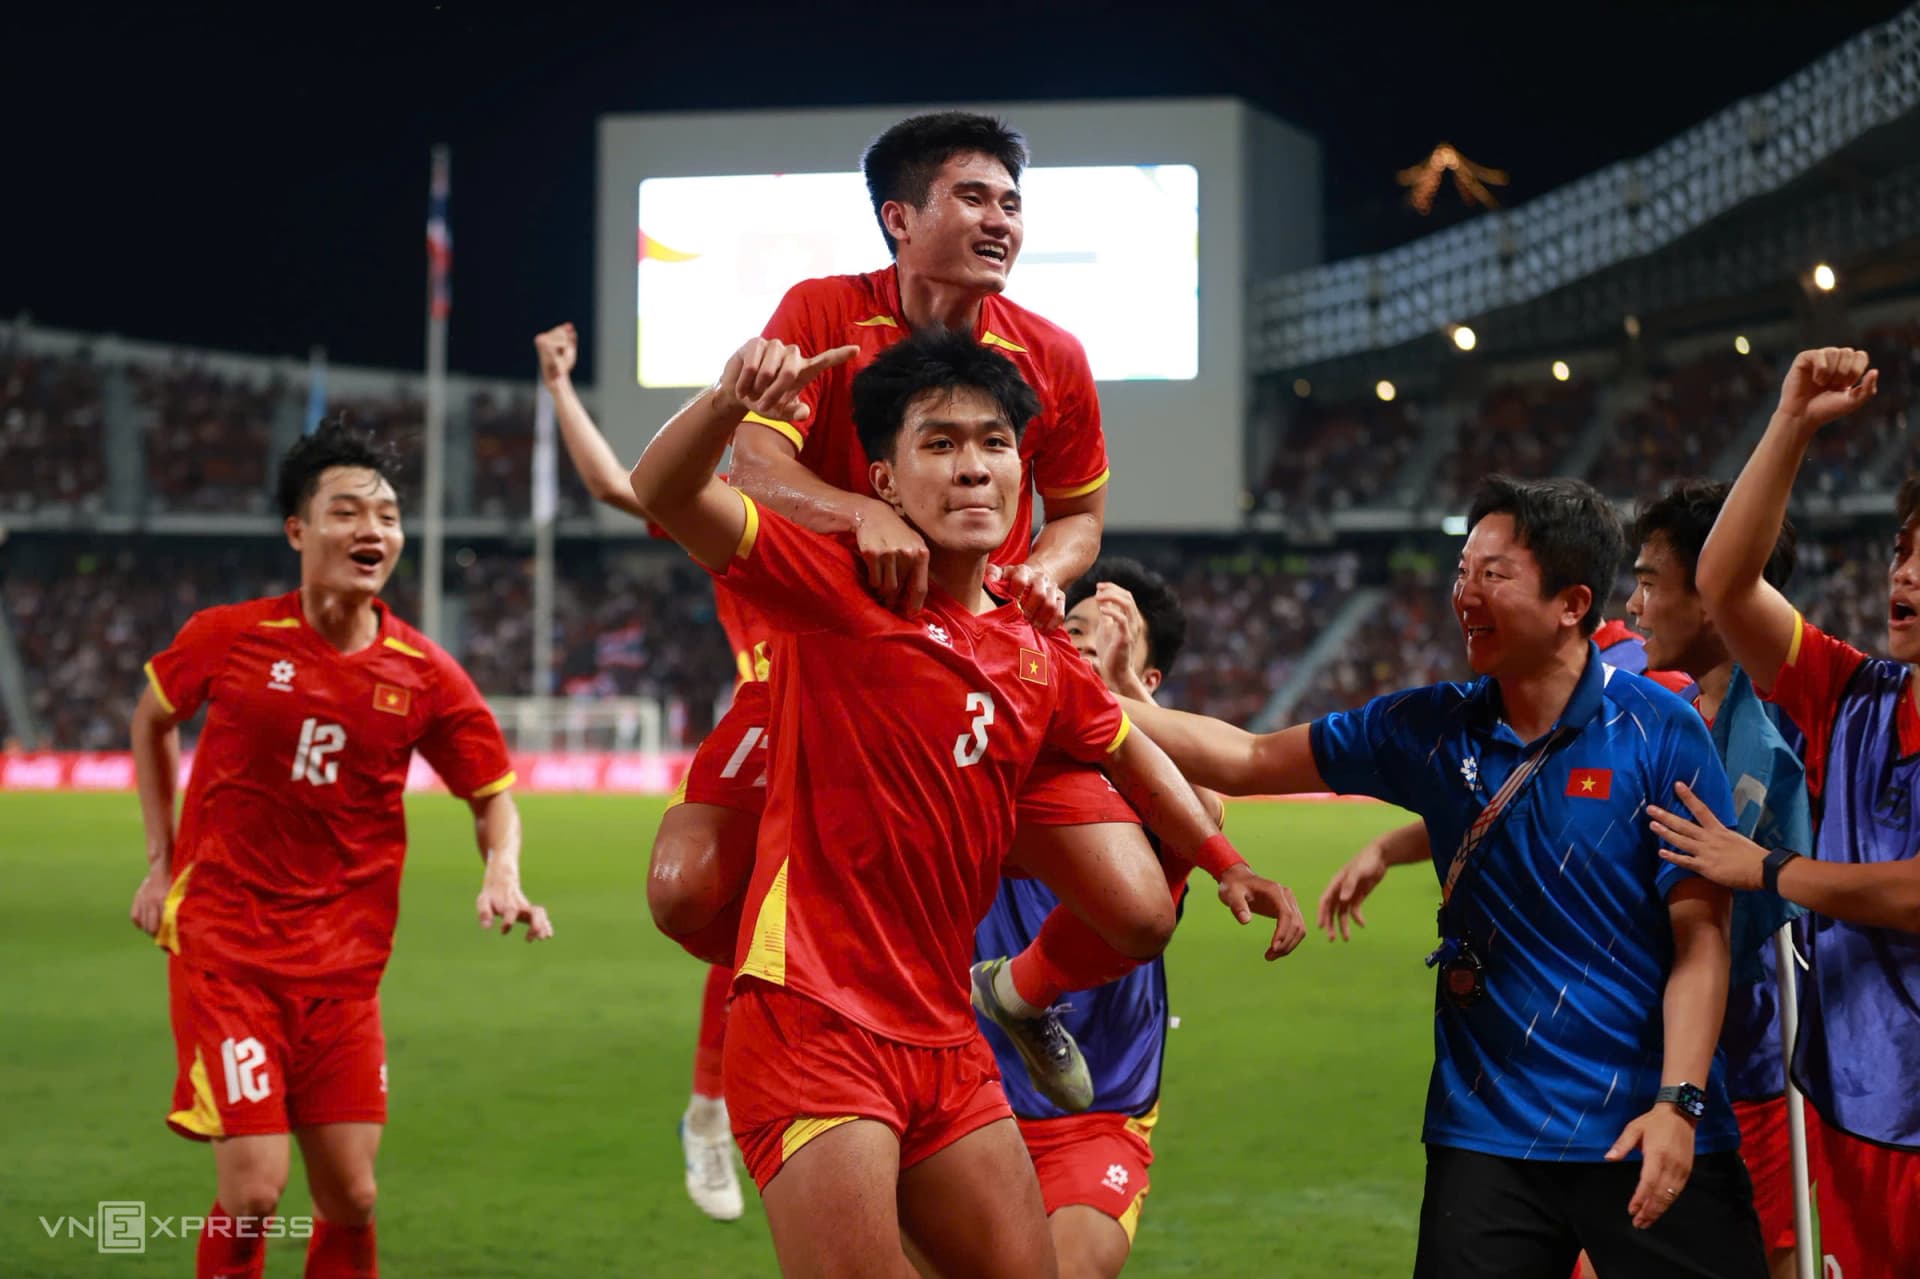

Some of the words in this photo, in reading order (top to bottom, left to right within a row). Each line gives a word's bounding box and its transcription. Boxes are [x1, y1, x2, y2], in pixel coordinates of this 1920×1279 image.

[291, 718, 346, 786] 12
[720, 727, 768, 787] 1
[953, 692, 995, 767] 3
[221, 1037, 272, 1105] 12
